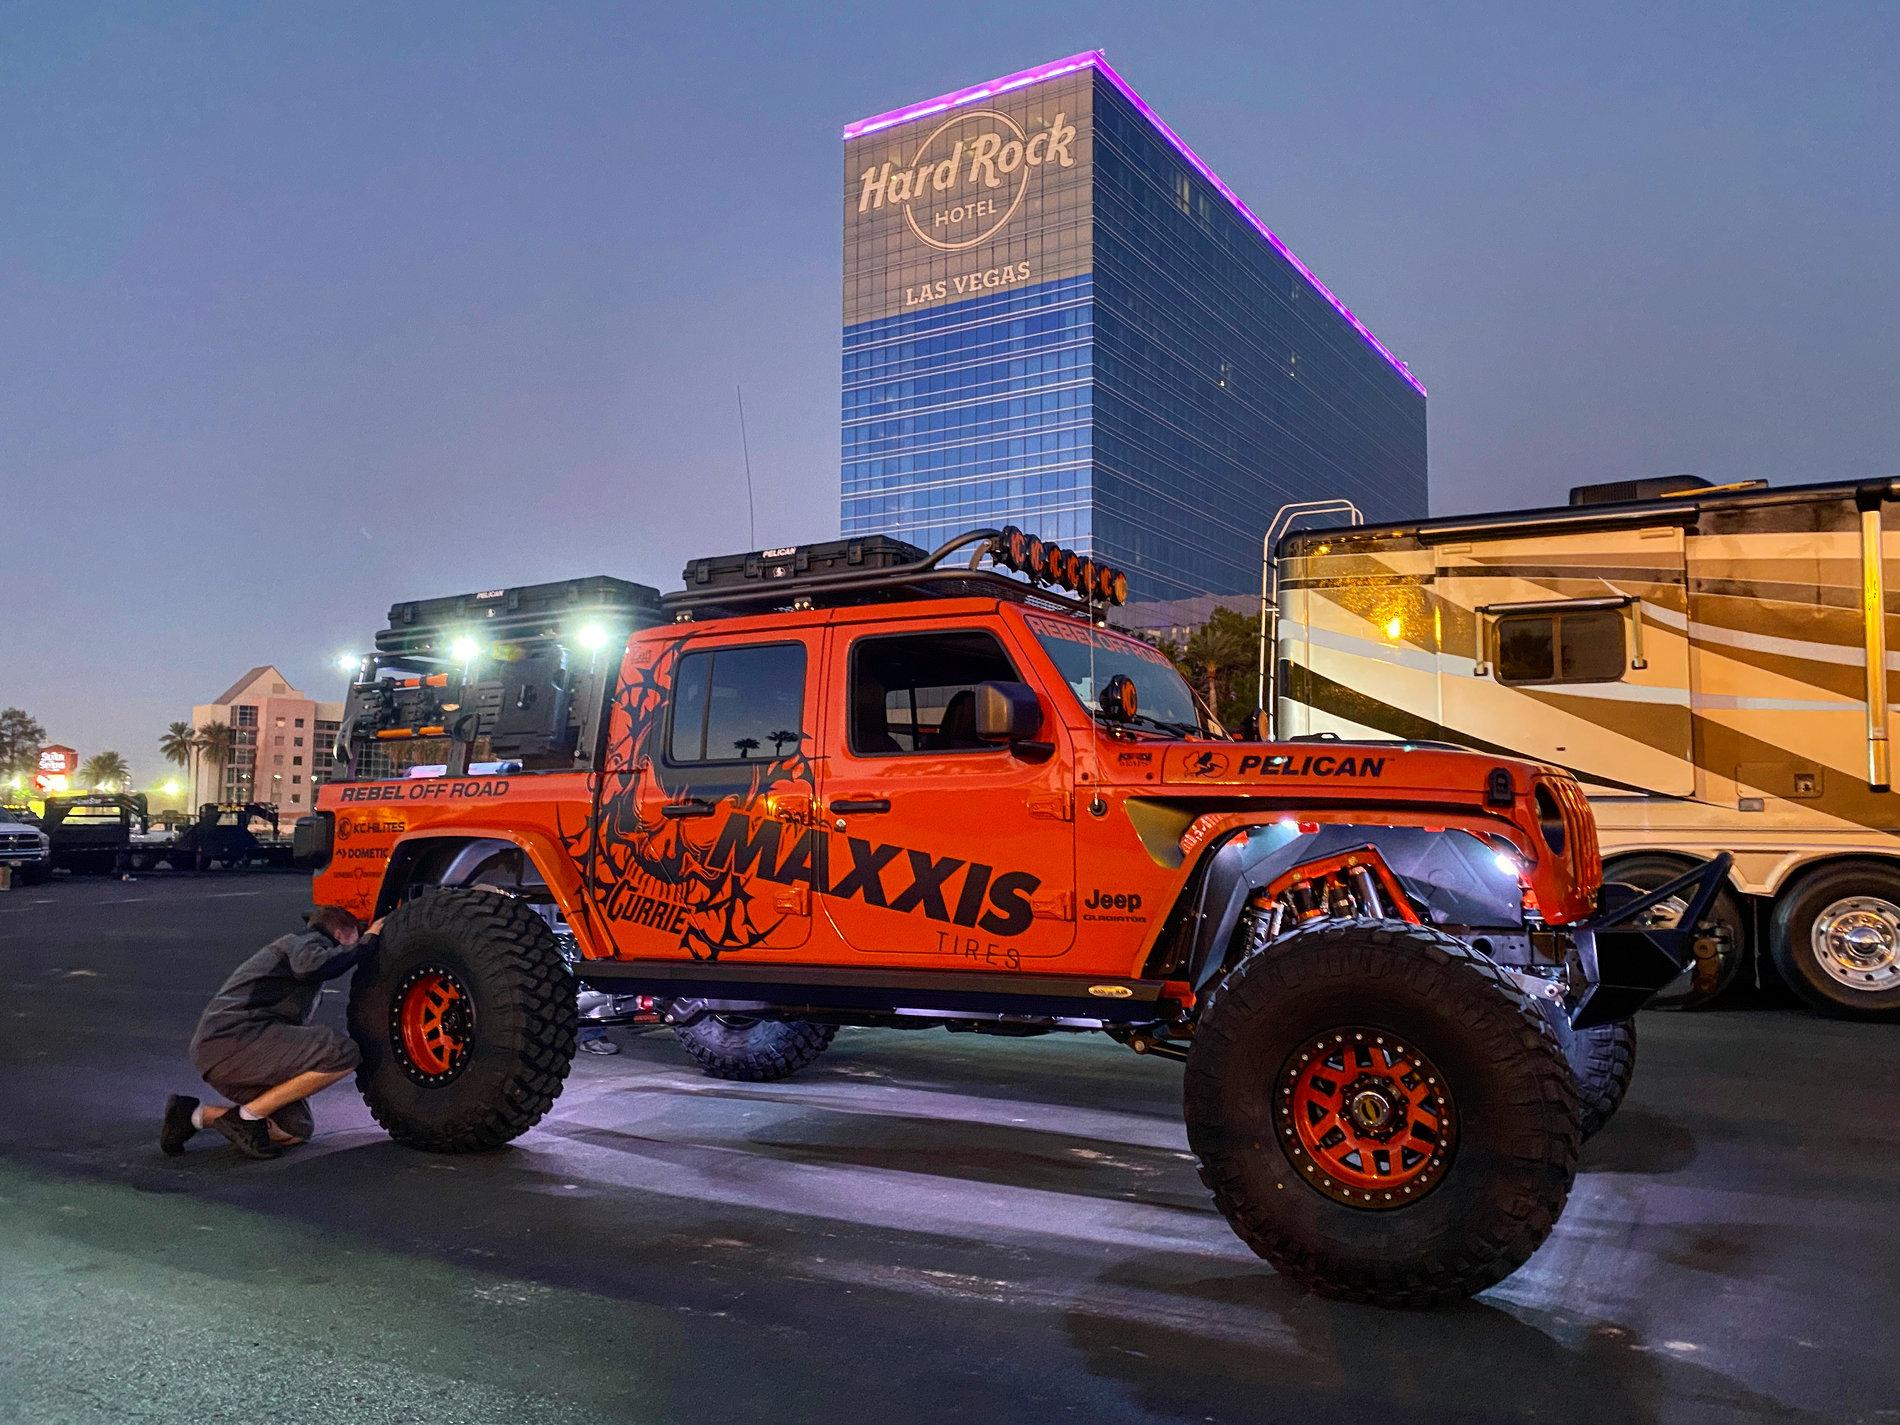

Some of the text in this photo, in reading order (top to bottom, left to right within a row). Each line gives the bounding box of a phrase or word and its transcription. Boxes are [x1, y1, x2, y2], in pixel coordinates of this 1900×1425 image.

[858, 112, 1077, 214] Hard Rock
[935, 199, 997, 227] HOTEL
[906, 261, 1031, 306] LAS VEGAS
[762, 546, 797, 558] PELICAN
[1028, 617, 1101, 649] REBEL
[1238, 755, 1386, 777] PELICAN
[340, 781, 509, 801] REBEL OFF ROAD
[348, 848, 389, 858] DOMETIC
[707, 812, 1042, 936] MAXXIS
[1084, 889, 1142, 913] Jeep
[1083, 914, 1147, 923] GLADIATOR
[936, 931, 1020, 969] TIRES
